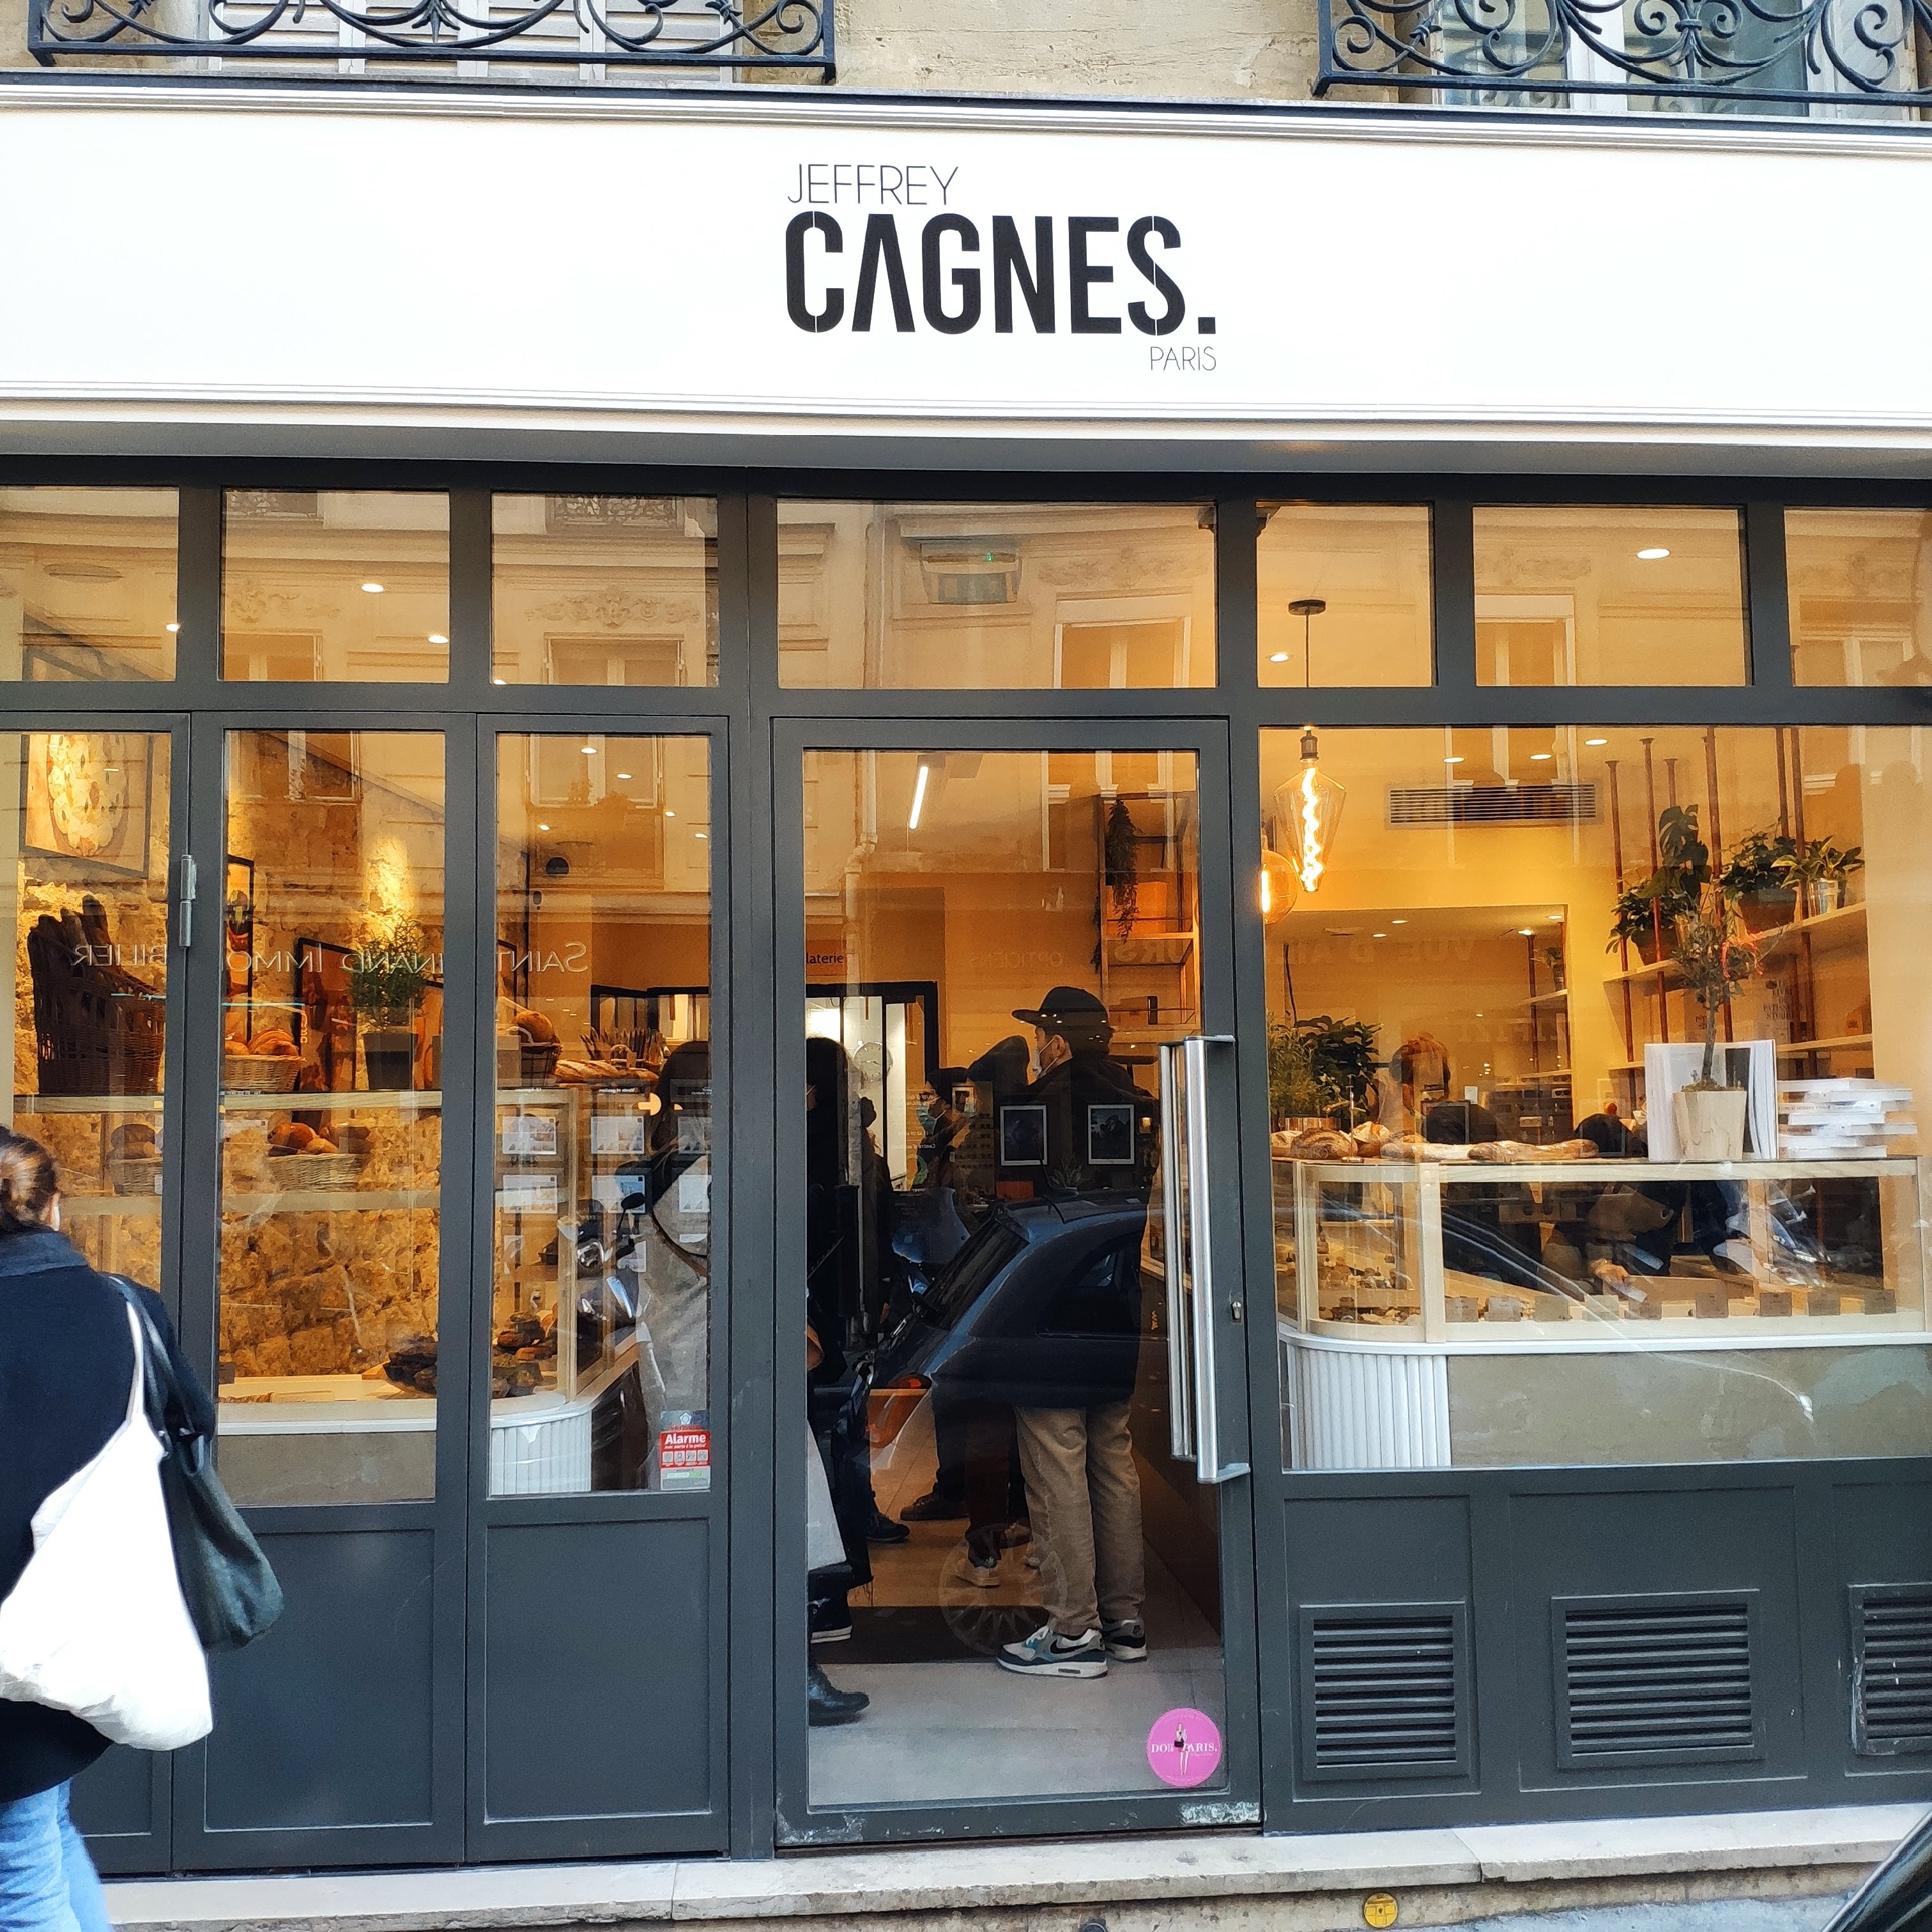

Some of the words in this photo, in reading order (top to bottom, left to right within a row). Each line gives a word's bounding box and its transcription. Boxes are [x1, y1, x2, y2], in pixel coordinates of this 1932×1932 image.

[788, 164, 958, 205] JEFFREY
[786, 211, 1216, 335] CAGNES.
[1150, 346, 1216, 371] PARIS
[806, 952, 844, 964] laterie
[664, 1434, 706, 1445] Alarme
